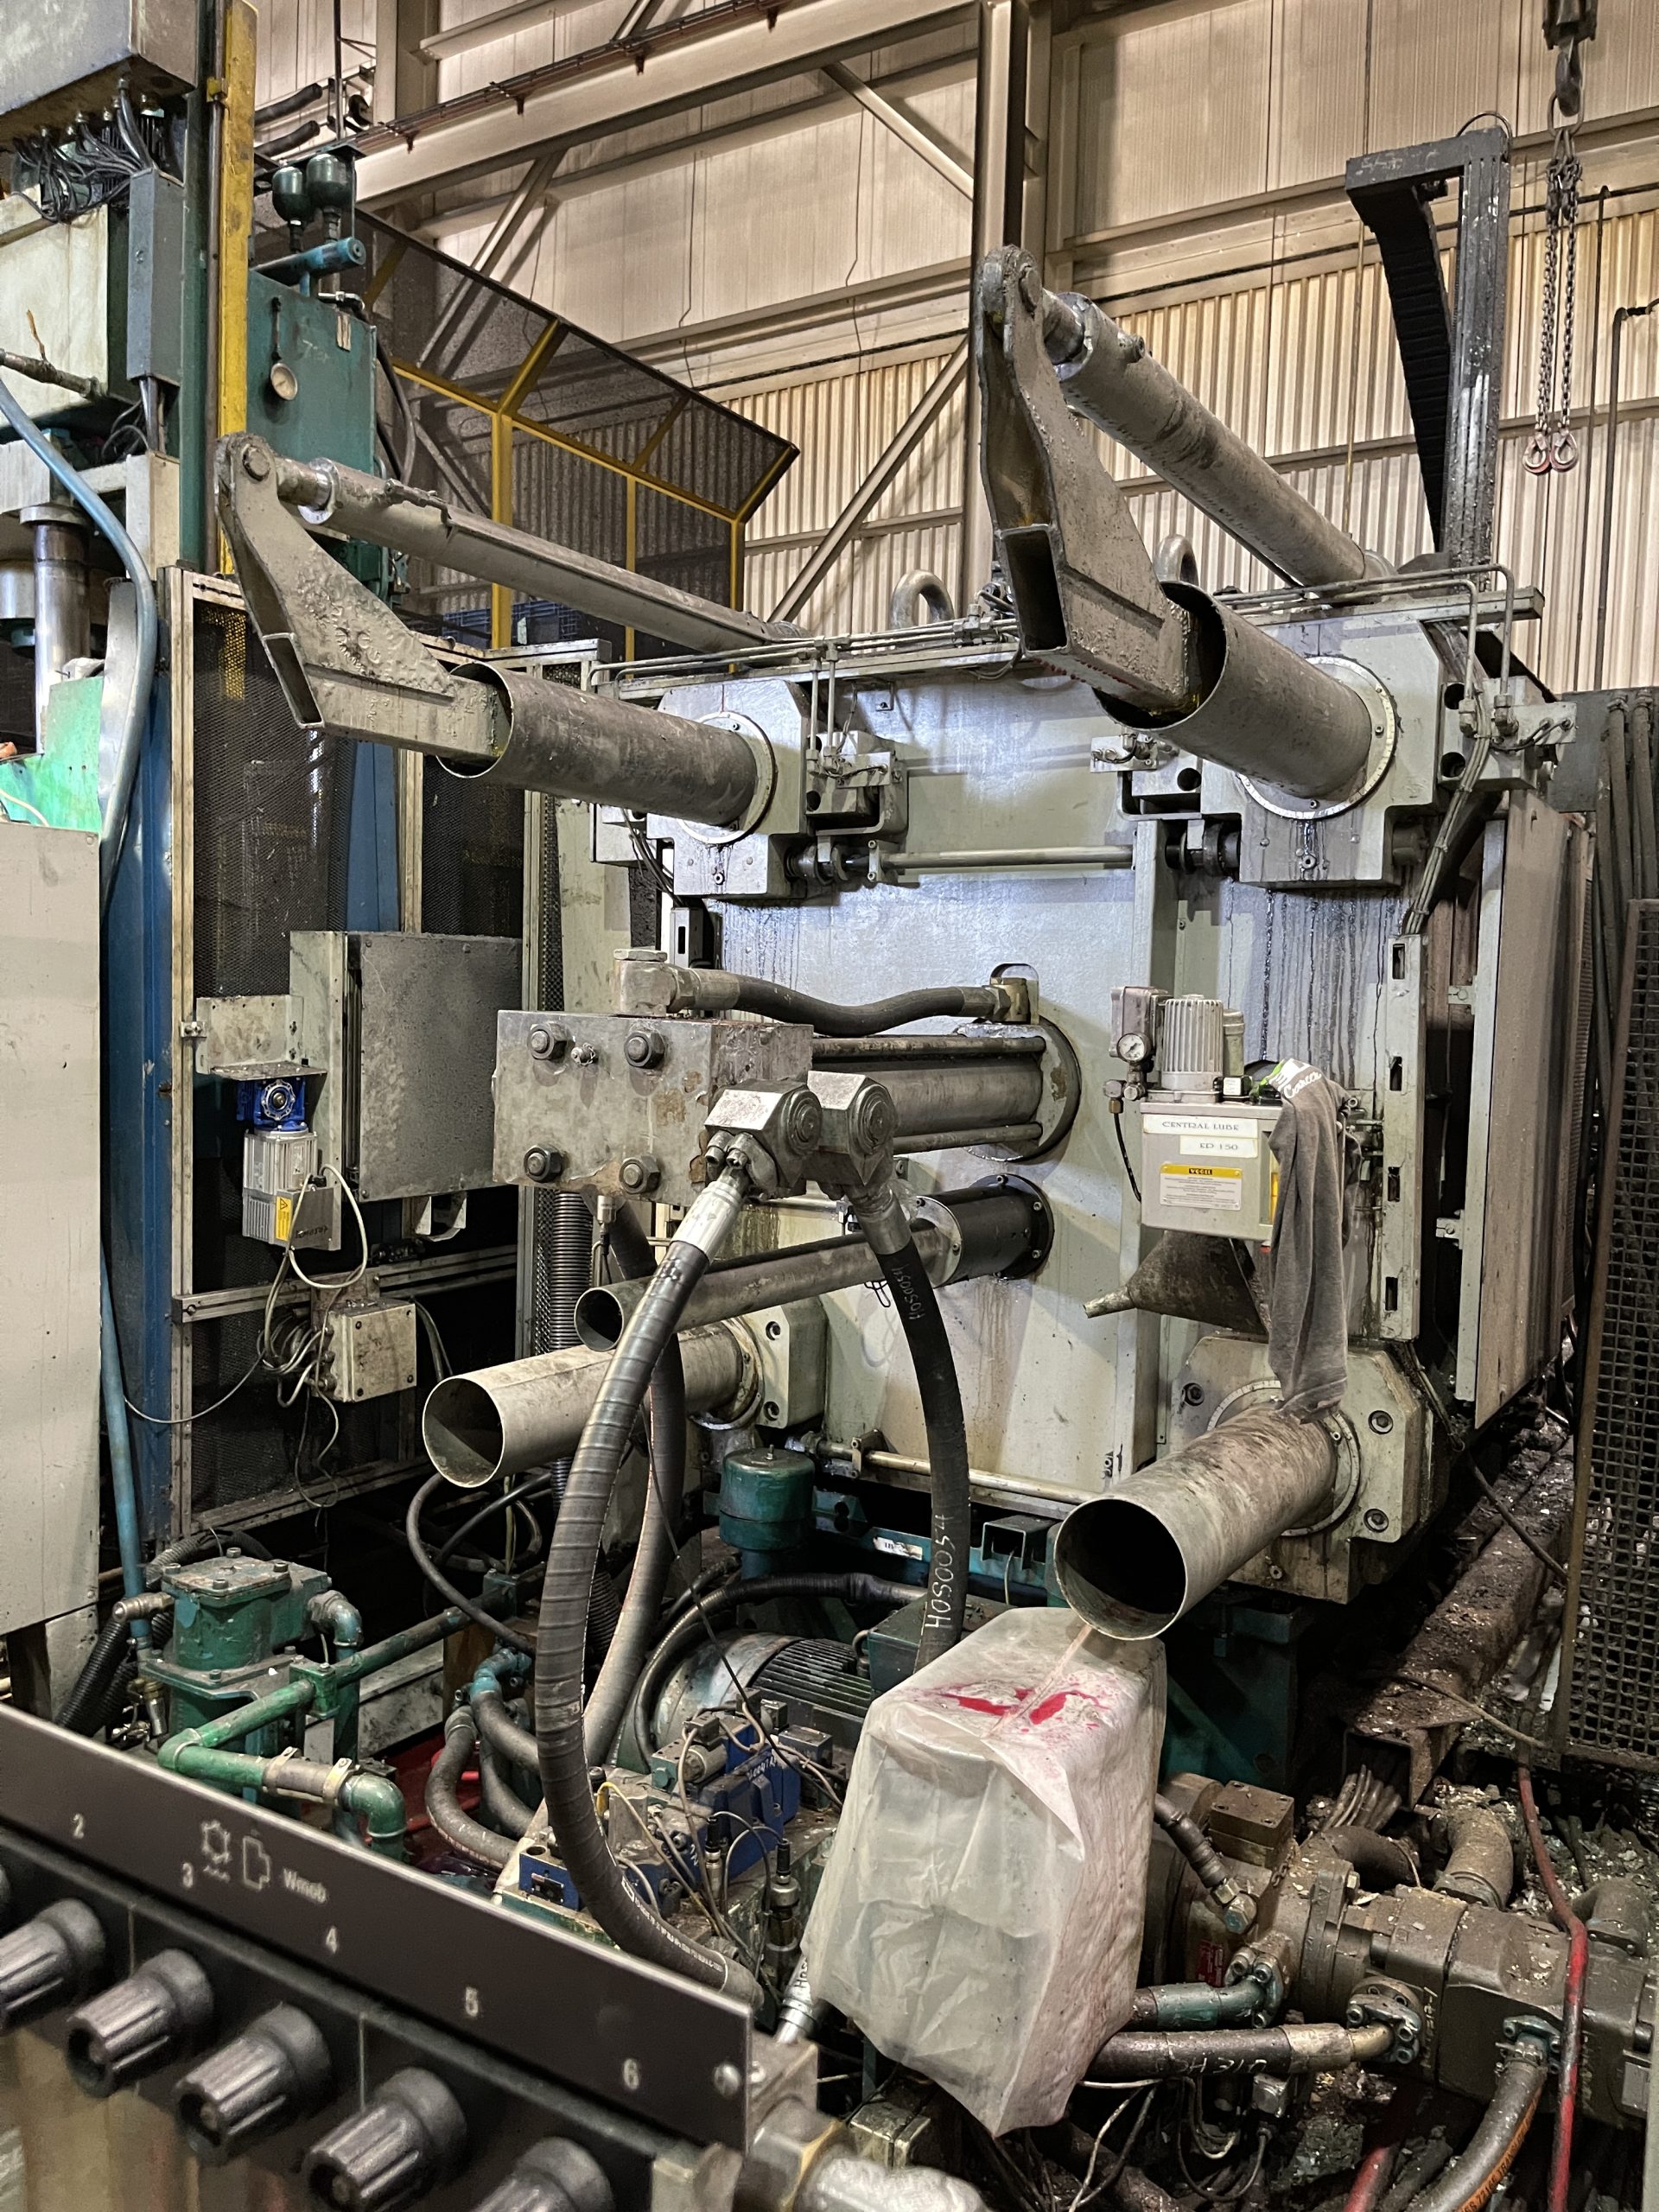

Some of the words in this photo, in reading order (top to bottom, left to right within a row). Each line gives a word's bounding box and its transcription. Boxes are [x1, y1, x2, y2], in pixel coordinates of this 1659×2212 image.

[1162, 1121, 1210, 1129] CENTRAL
[925, 1514, 955, 1628] HOS0054
[73, 1813, 85, 1840] 2
[182, 1862, 194, 1888] 3
[326, 1925, 338, 1955] 4
[622, 2057, 640, 2091] 6
